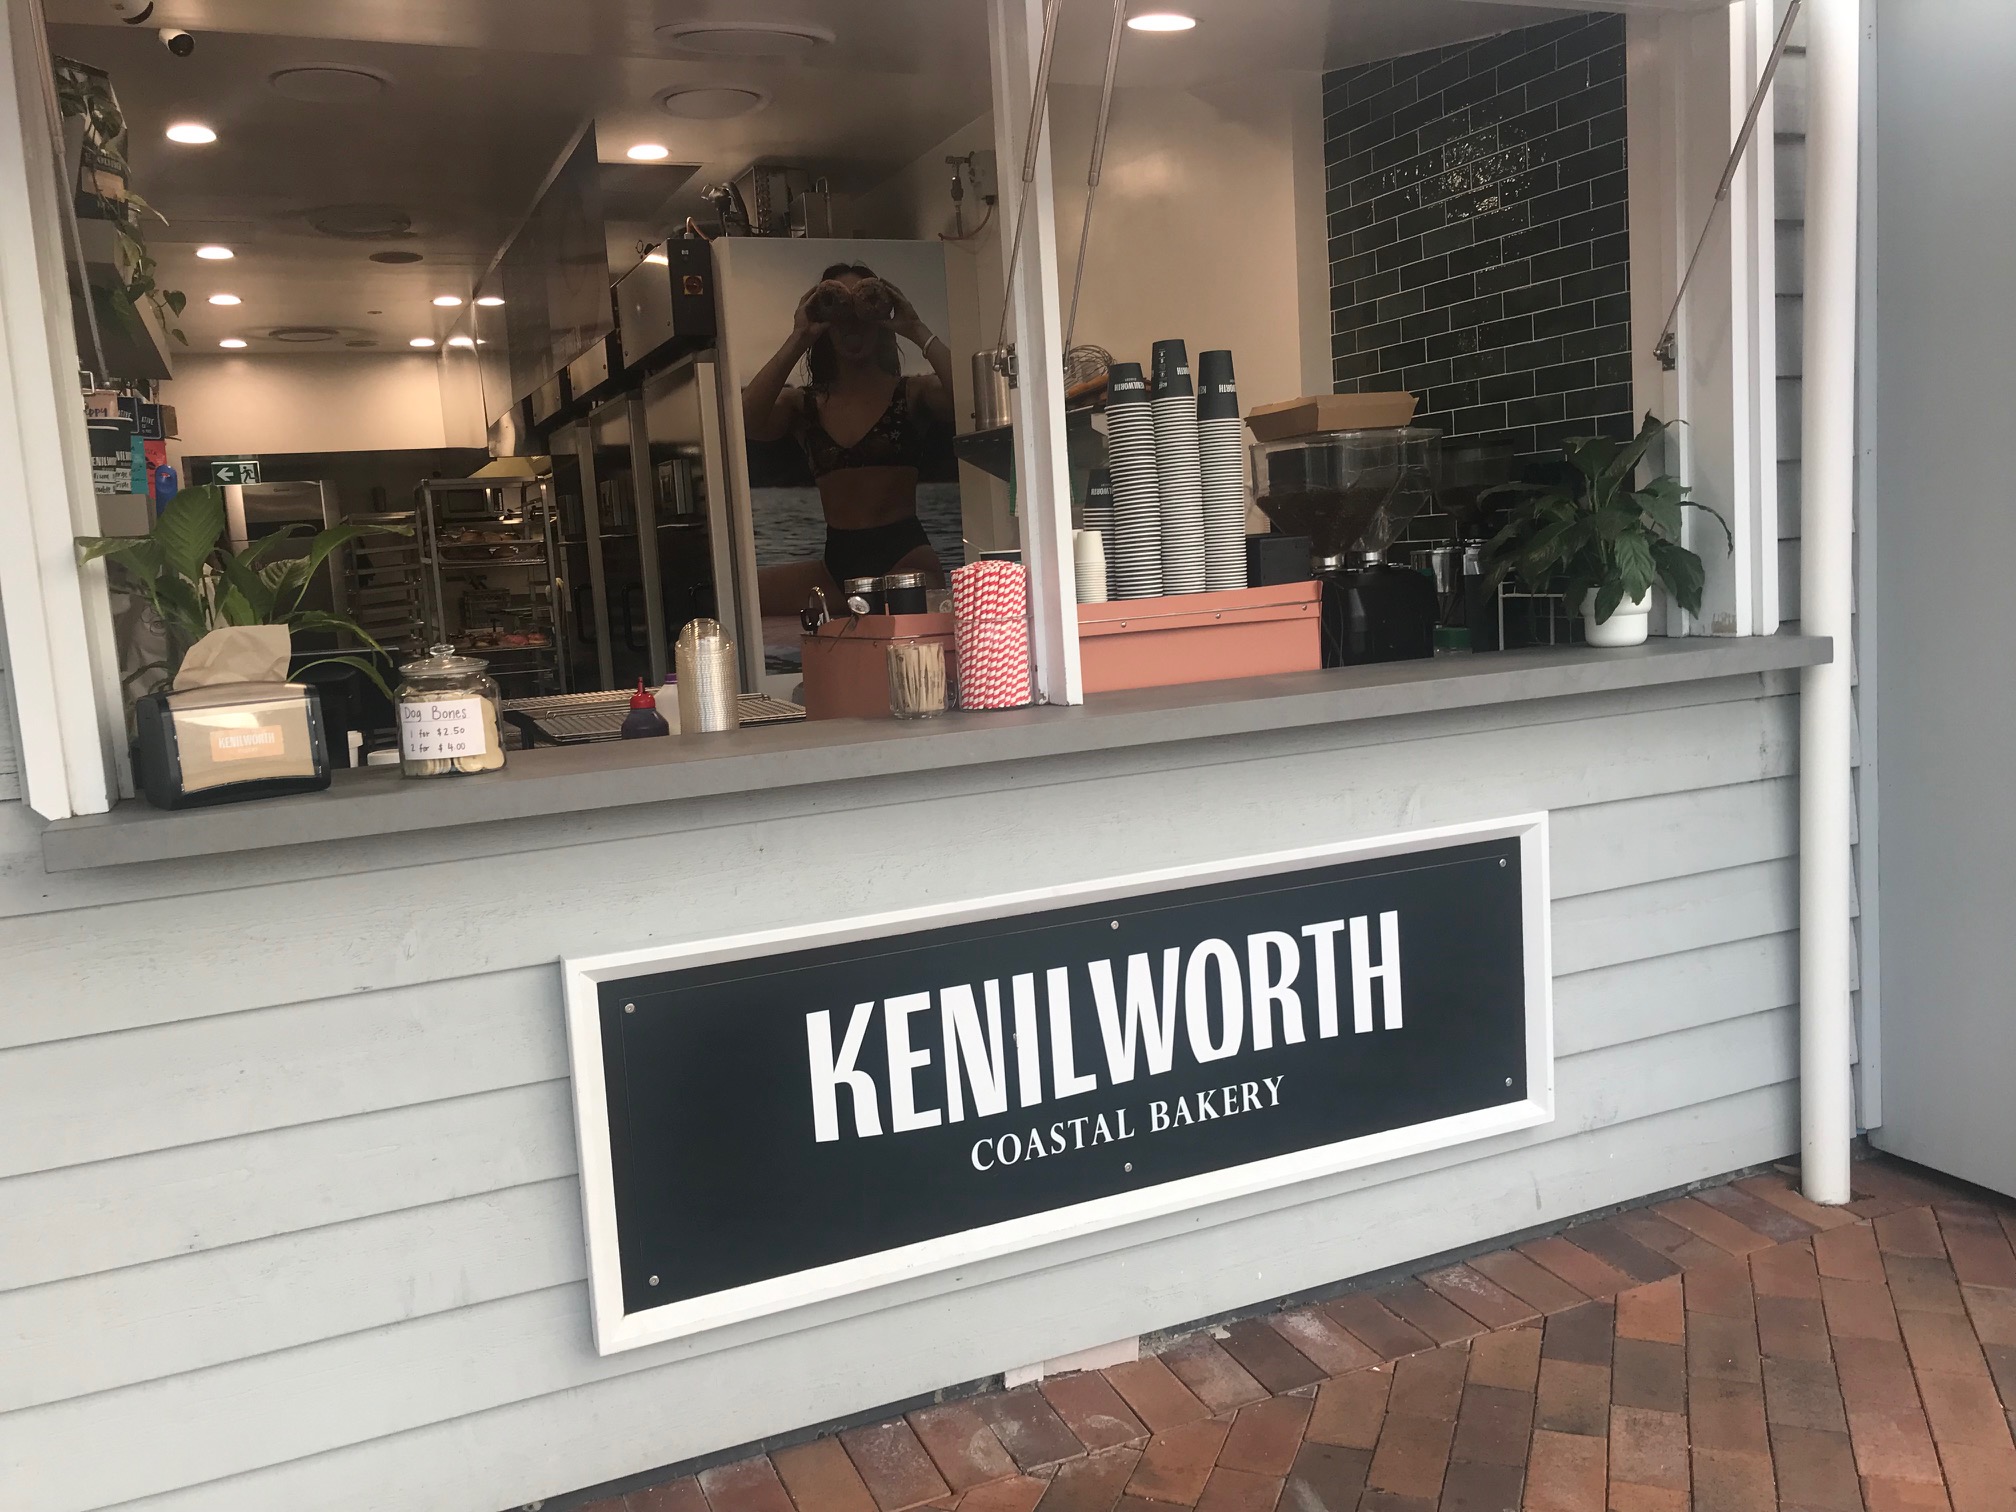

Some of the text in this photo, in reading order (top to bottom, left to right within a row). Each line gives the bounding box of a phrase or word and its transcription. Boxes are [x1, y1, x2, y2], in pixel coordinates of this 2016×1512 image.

[404, 705, 467, 722] Dog Bones
[218, 732, 275, 749] KENILWORTH
[409, 726, 465, 738] 1 for $2.50
[410, 743, 416, 752] 2
[419, 743, 430, 753] for
[806, 910, 1403, 1143] KENILWORTH
[971, 1074, 1285, 1172] COASTAL BAKERY
